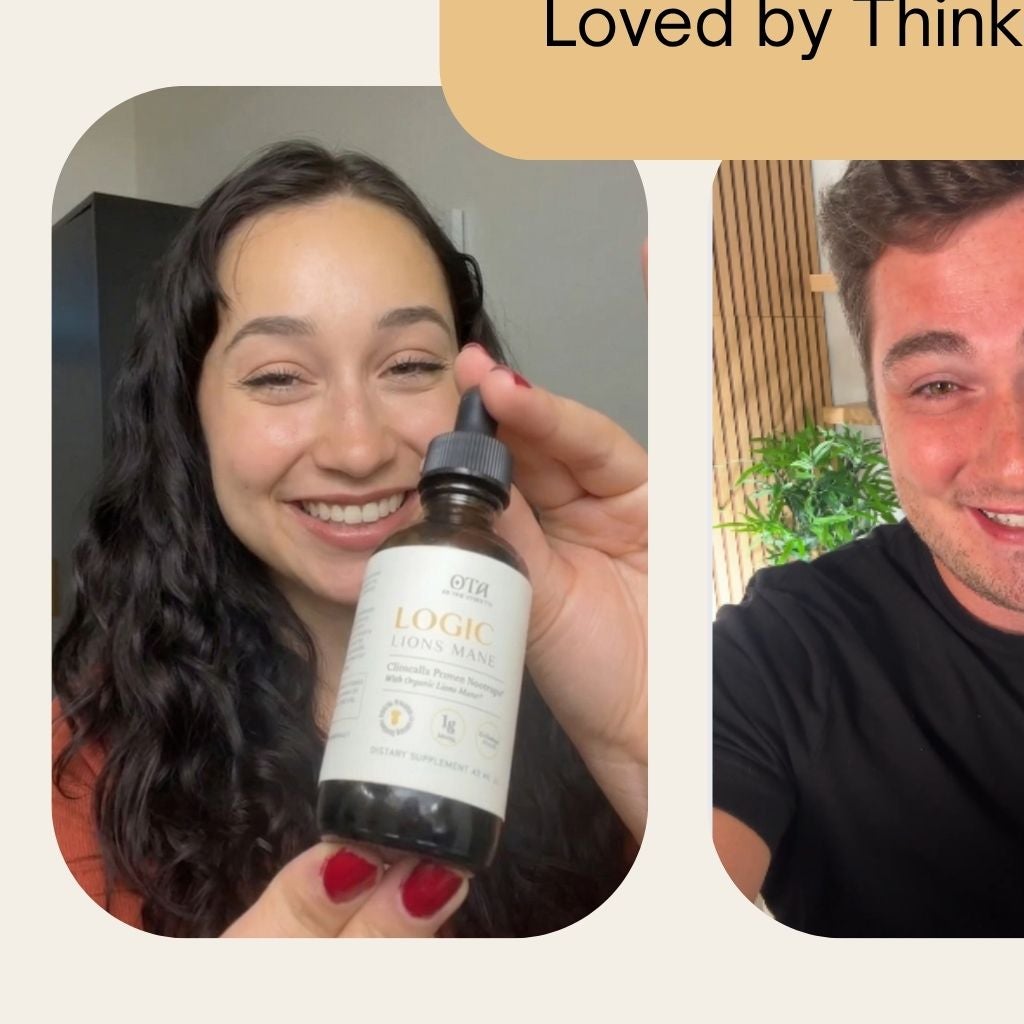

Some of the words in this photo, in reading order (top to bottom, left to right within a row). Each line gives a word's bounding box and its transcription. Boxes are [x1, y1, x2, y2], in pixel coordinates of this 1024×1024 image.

[394, 606, 495, 646] LOGIC
[391, 634, 443, 652] LIONS
[452, 643, 496, 669] MANE
